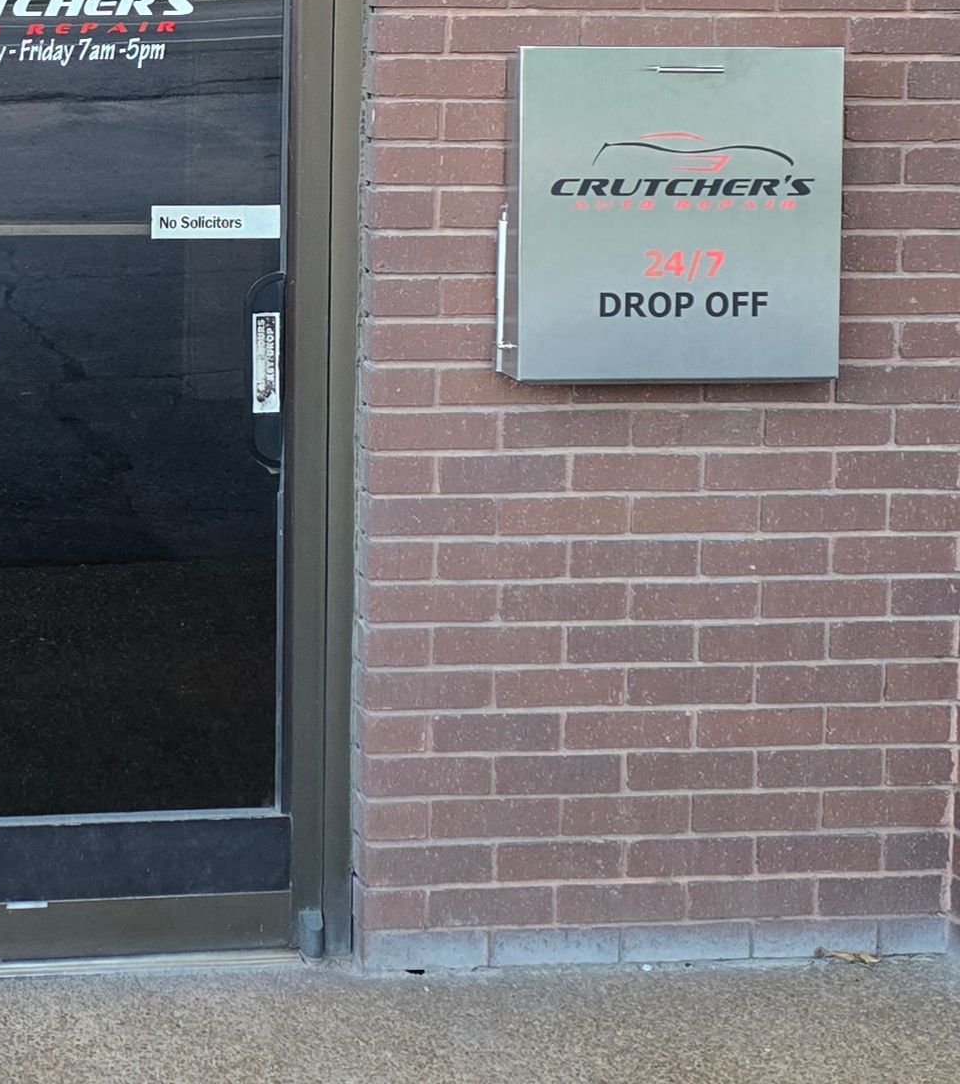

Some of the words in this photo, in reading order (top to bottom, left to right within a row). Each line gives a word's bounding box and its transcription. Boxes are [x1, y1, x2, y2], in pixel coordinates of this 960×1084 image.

[26, 21, 176, 36] REPAIR
[19, 37, 74, 66] Friday
[78, 38, 115, 61] 7am
[550, 175, 815, 197] CRUTCHER'S
[570, 199, 656, 211] AUTO
[674, 199, 798, 211] REPAIR
[159, 216, 177, 229] No
[180, 216, 242, 229] Solicitors
[644, 250, 726, 282] 24/7
[599, 292, 695, 318] DROP
[705, 292, 769, 317] OFF
